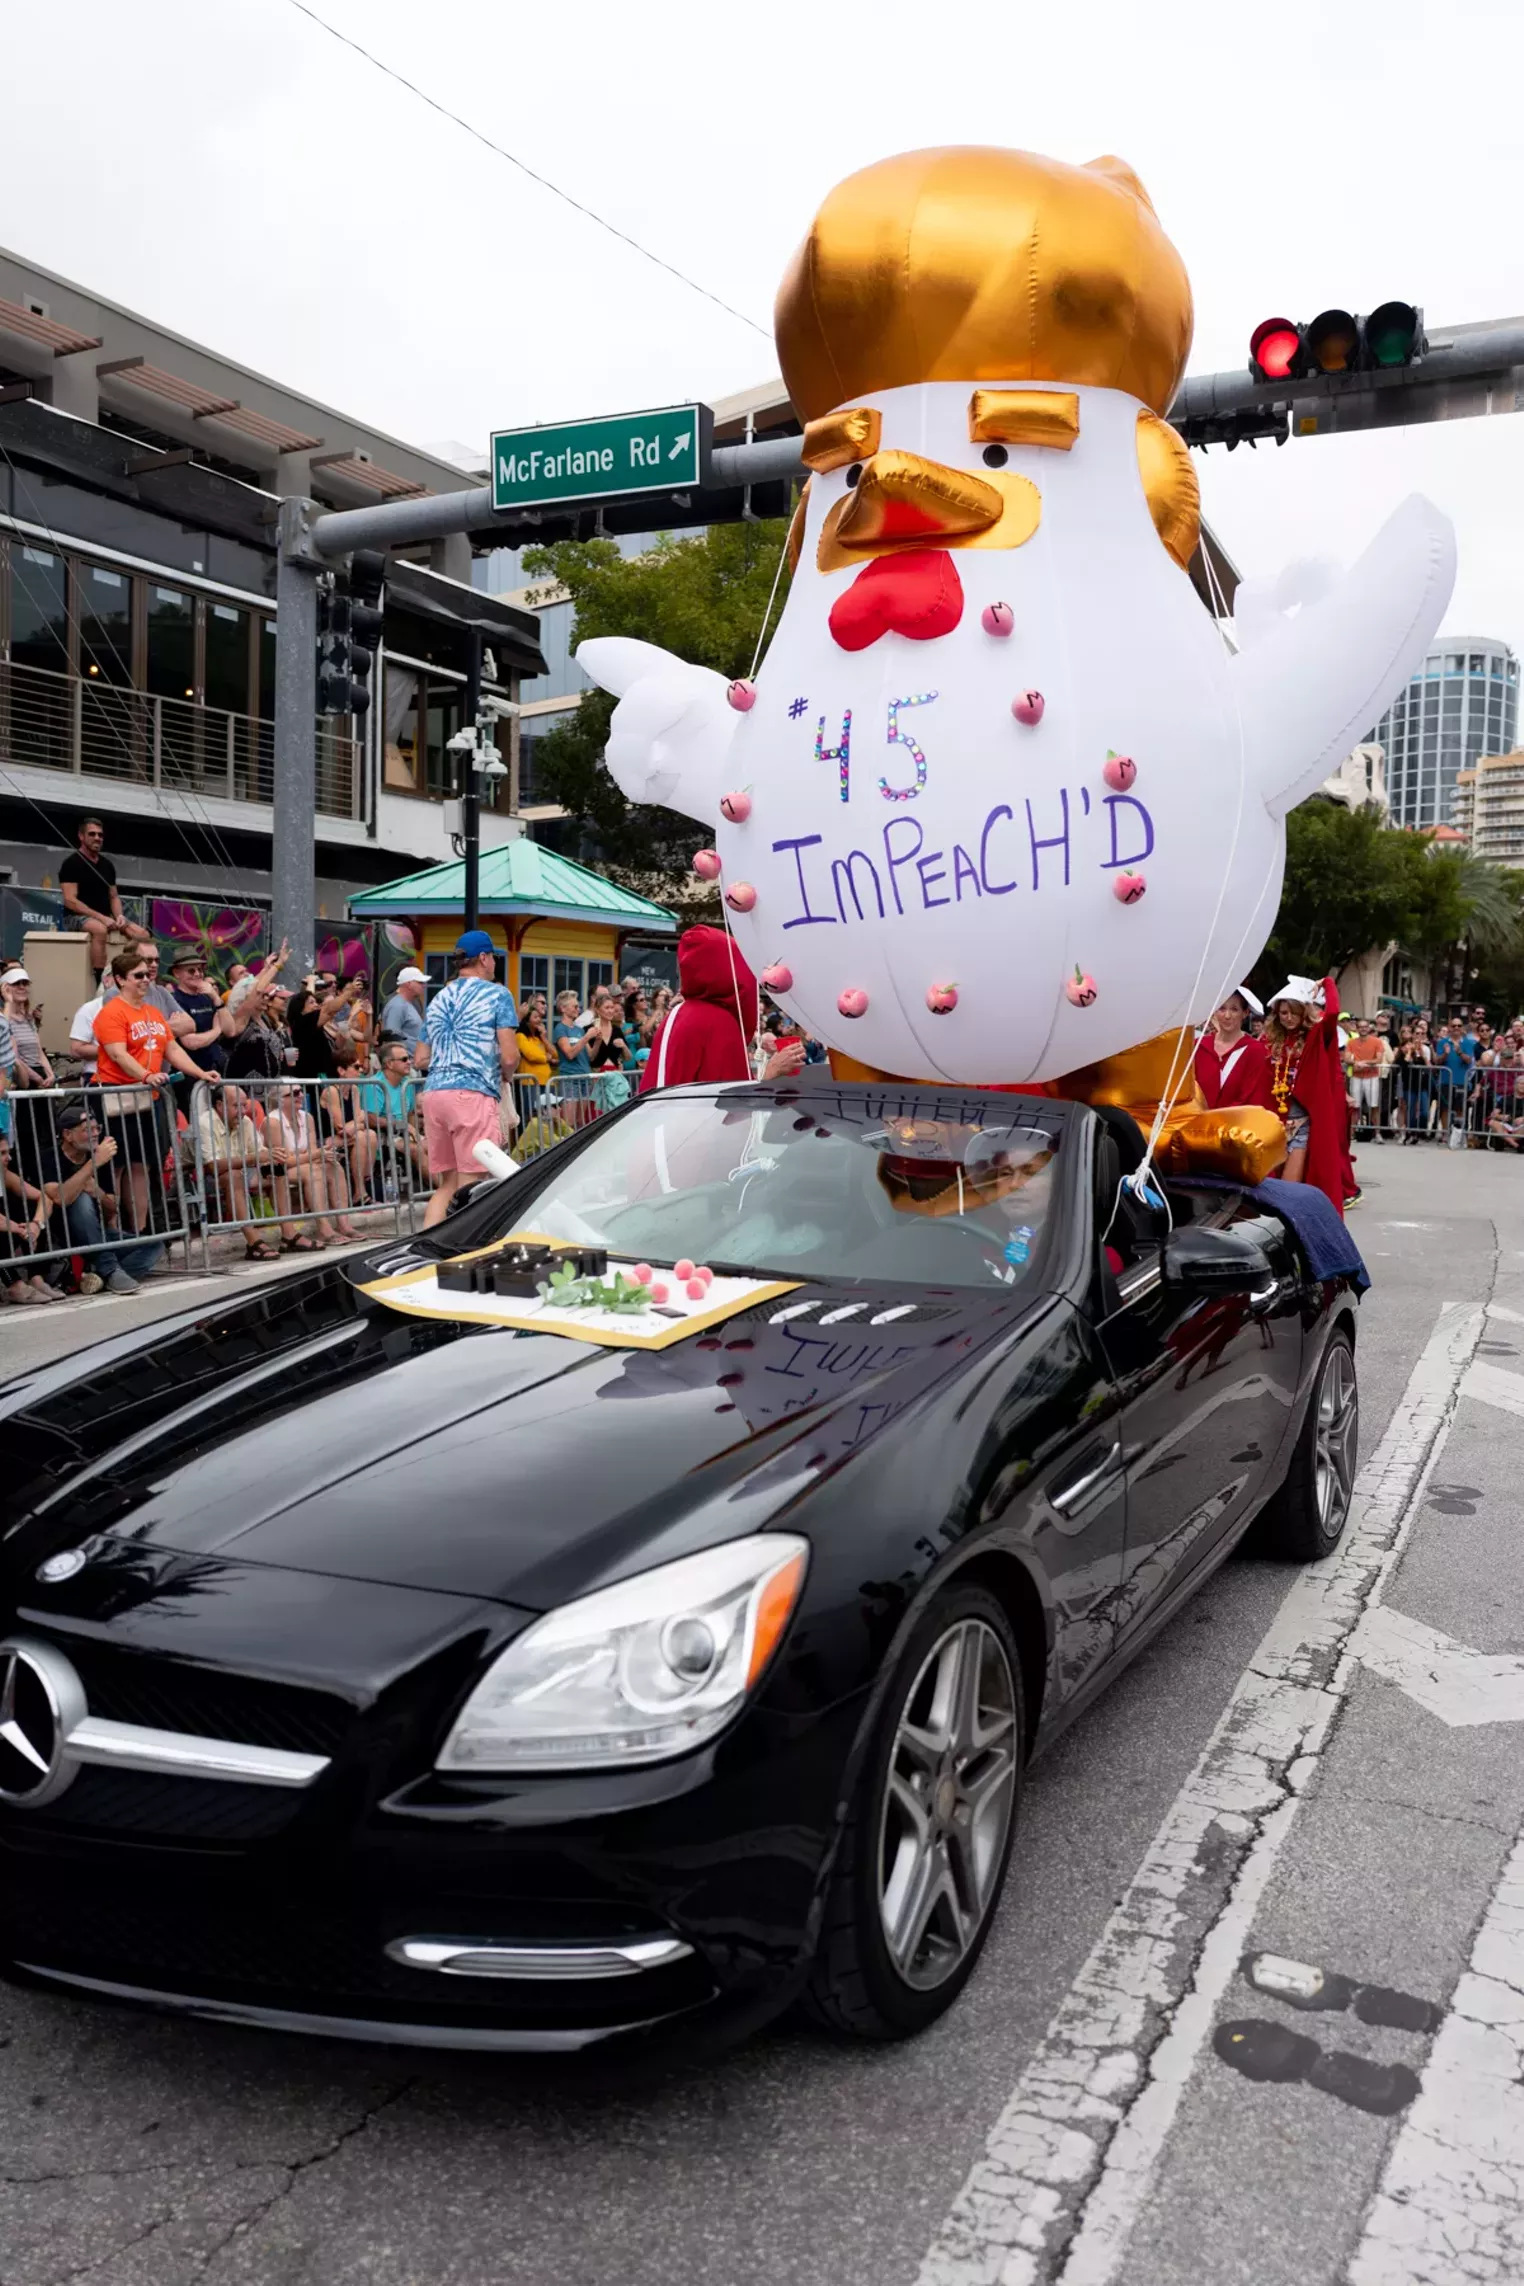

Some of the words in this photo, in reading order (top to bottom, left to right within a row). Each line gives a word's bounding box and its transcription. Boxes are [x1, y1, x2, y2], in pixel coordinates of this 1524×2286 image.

[500, 447, 613, 484] McFarlane
[630, 435, 660, 467] Rd
[22, 911, 55, 925] RETAIL
